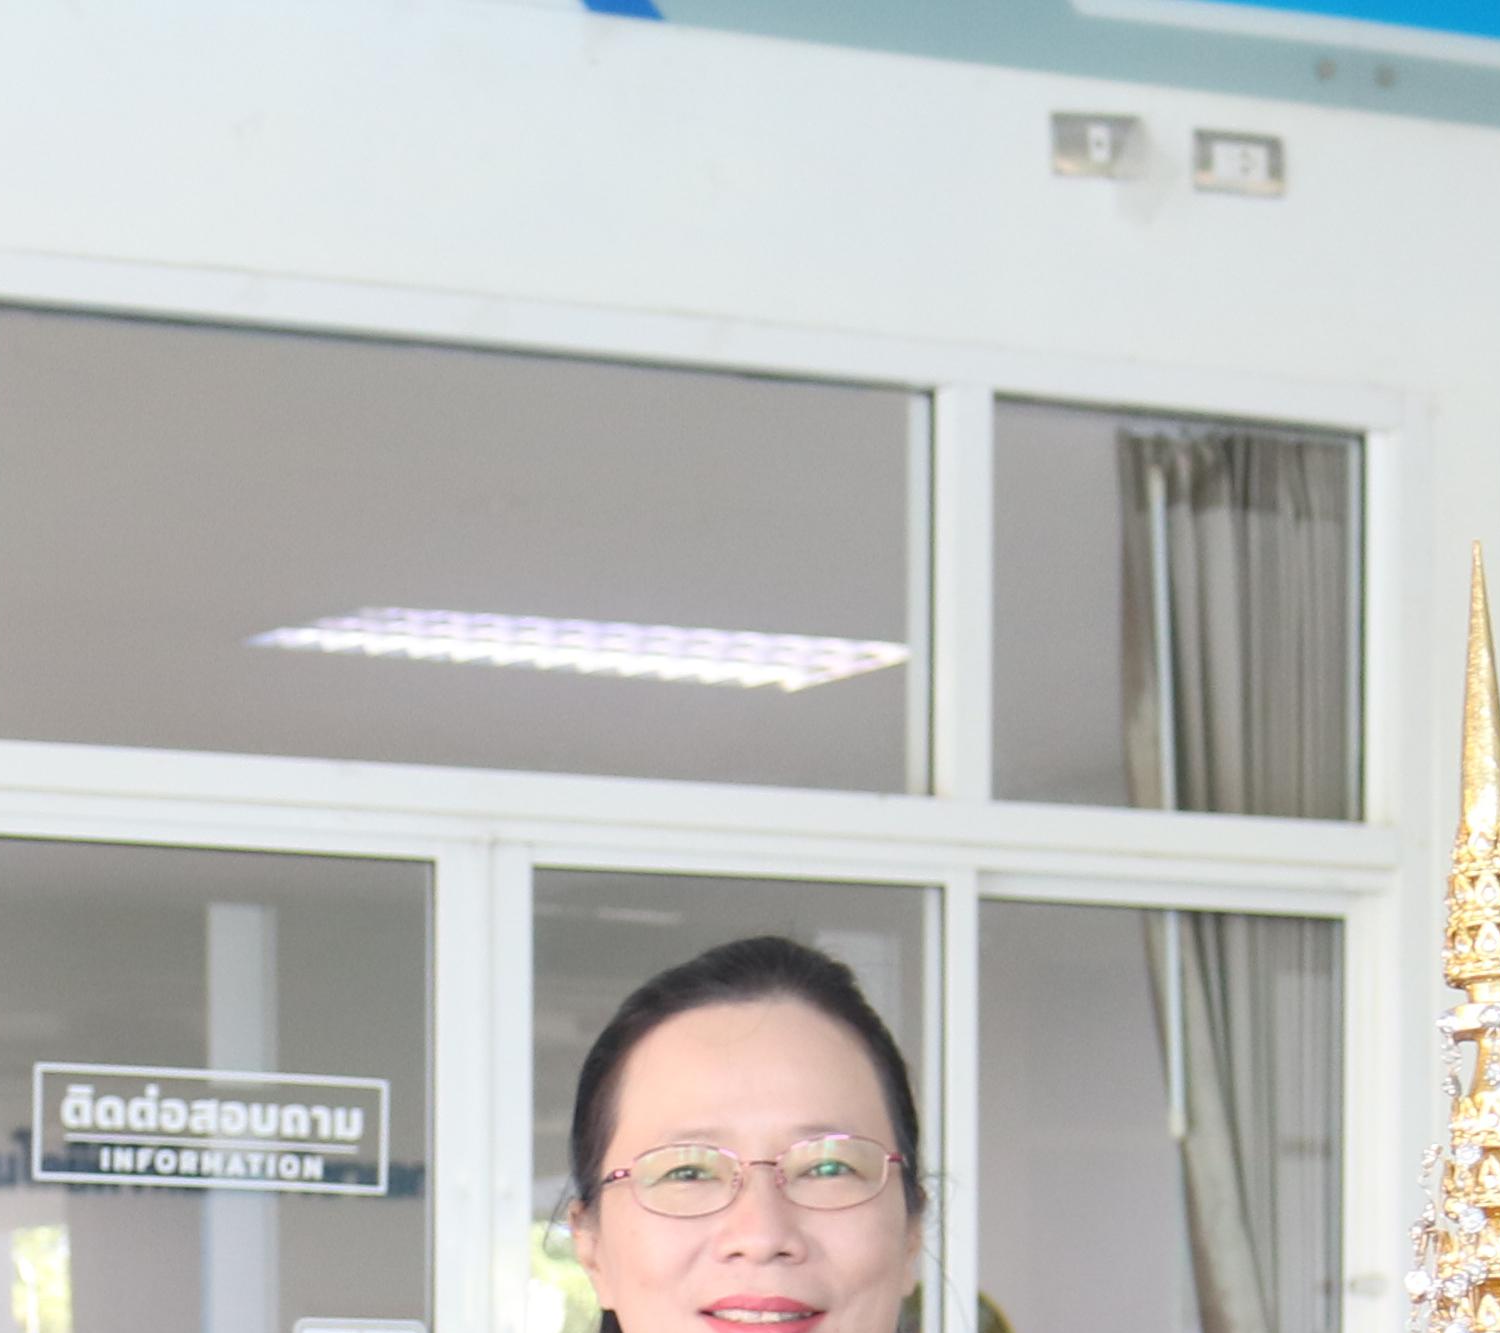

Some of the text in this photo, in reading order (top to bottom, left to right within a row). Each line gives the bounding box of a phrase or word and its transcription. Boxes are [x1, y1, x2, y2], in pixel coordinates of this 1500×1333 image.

[60, 1082, 364, 1142] ติดต่อสอบถาม
[100, 1146, 325, 1182] INFORMATION
